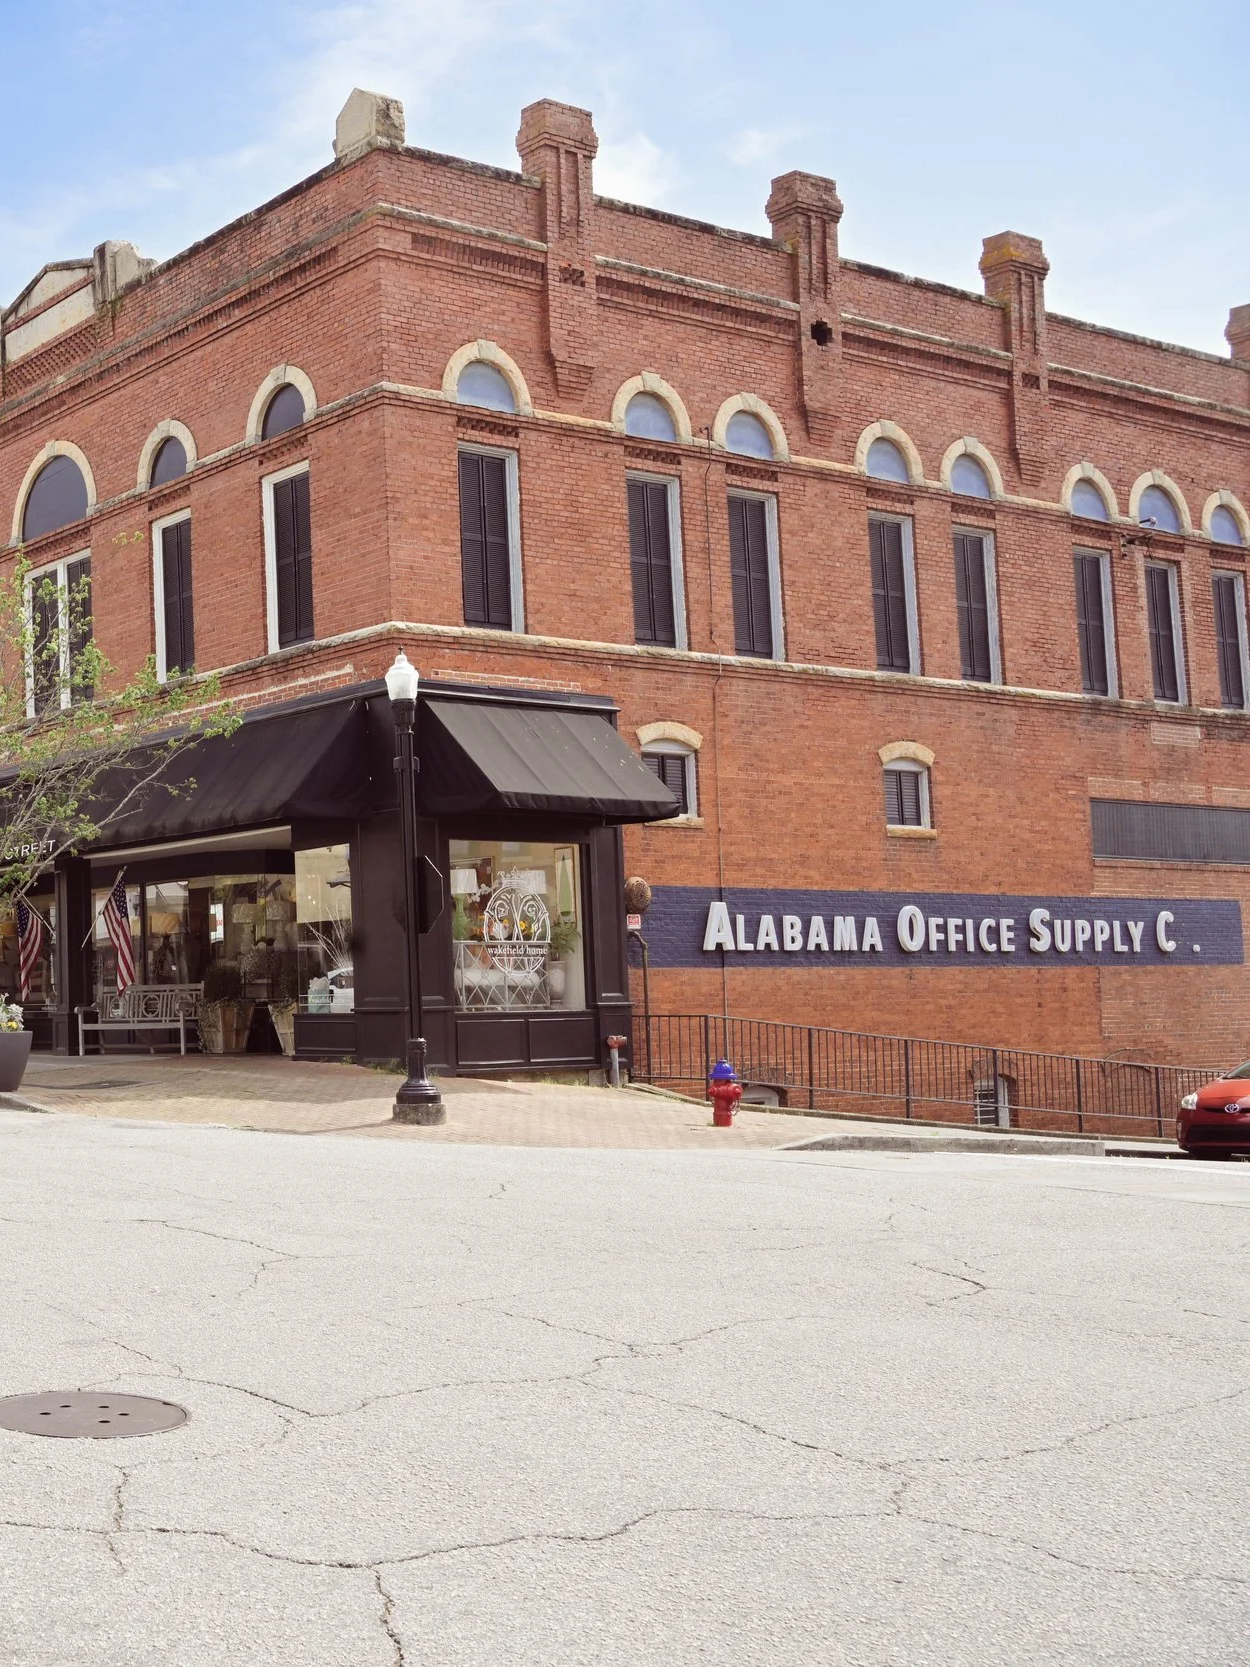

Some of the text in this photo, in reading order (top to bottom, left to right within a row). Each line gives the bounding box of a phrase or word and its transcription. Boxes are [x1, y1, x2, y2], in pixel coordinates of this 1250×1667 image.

[703, 901, 884, 951] ALABAMA
[897, 905, 1016, 952] OFFICE
[1029, 908, 1144, 952] SUPPLY
[487, 944, 548, 955] wakefield home
